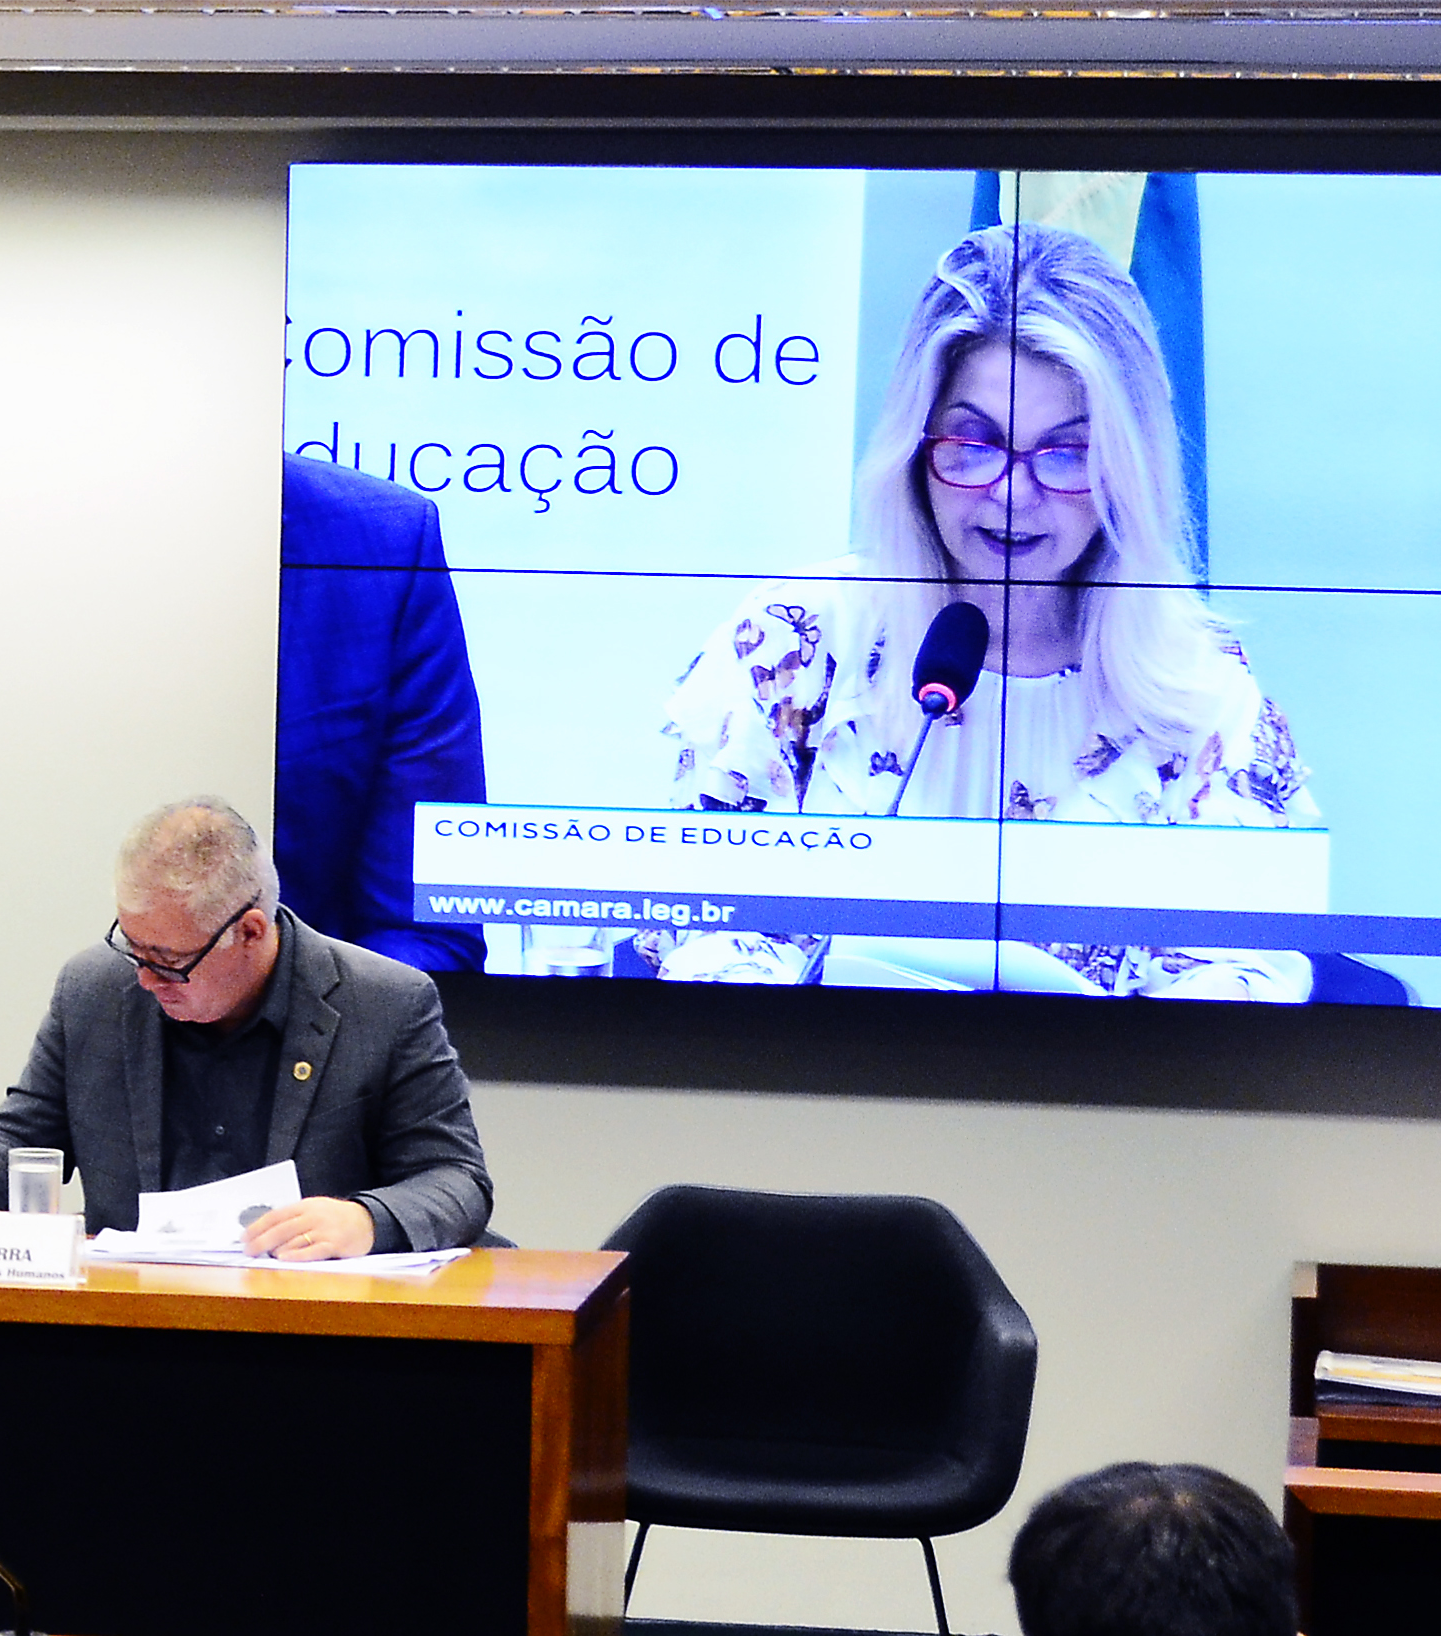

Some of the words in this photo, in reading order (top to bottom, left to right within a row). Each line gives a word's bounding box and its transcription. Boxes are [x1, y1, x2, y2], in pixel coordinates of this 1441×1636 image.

[285, 309, 678, 382] omissão
[714, 314, 819, 385] de
[294, 421, 679, 514] ducação
[435, 819, 611, 842] COMISSÃO
[625, 826, 666, 843] DE
[681, 827, 873, 851] EDUCAÇÃO
[429, 895, 735, 925] www.camara.leg.br
[6, 1269, 65, 1279] Humanos
